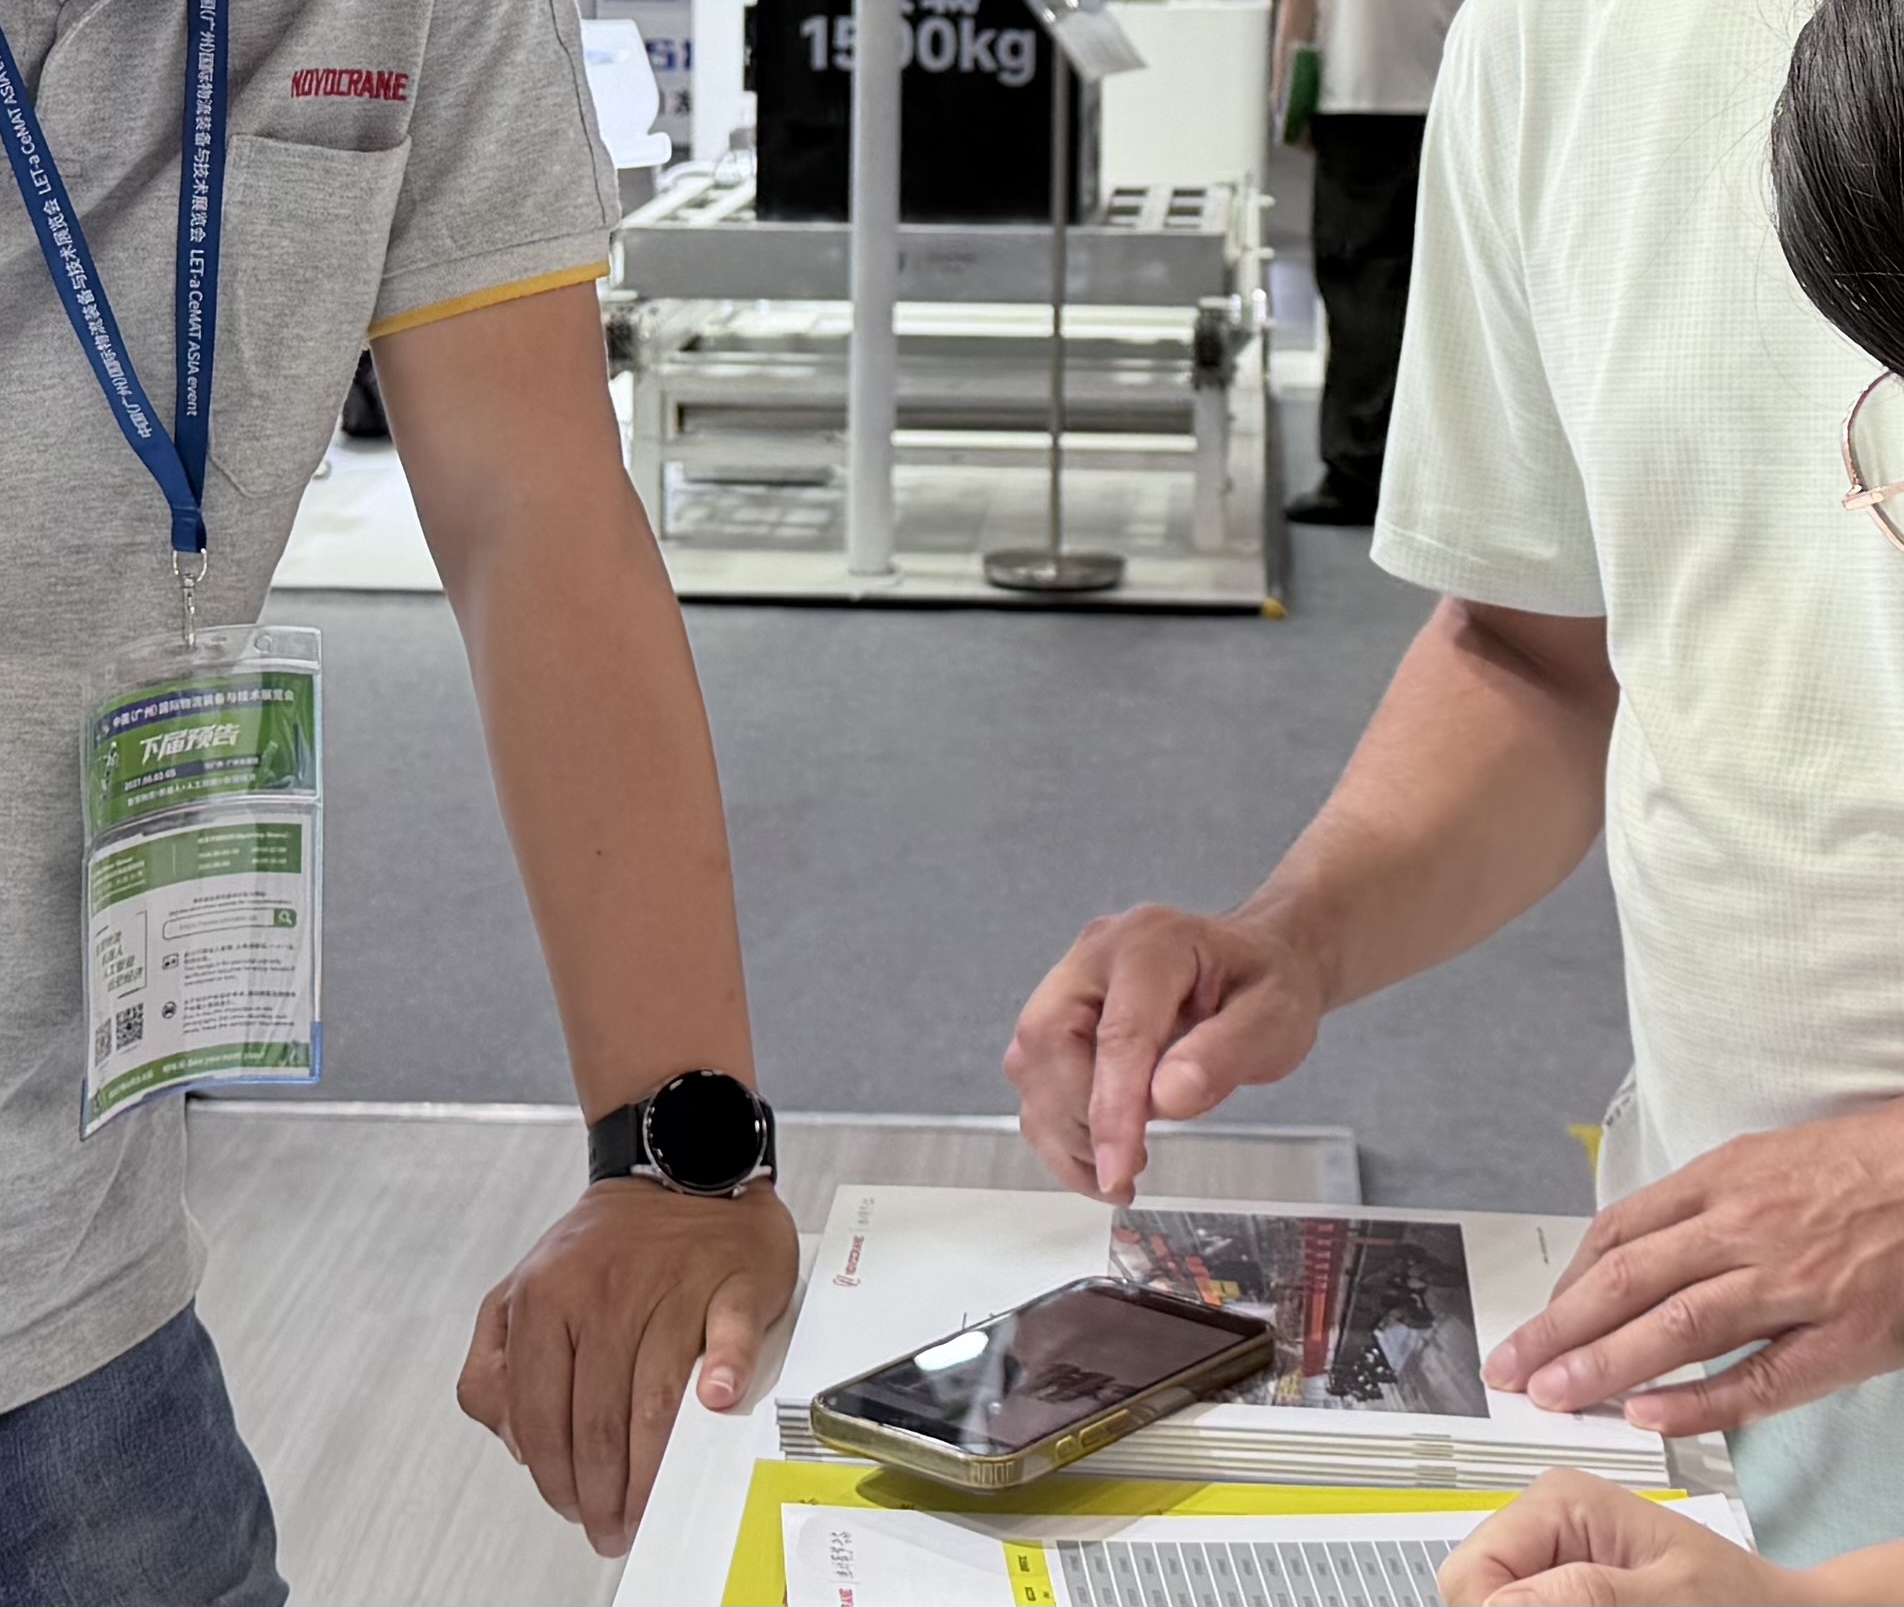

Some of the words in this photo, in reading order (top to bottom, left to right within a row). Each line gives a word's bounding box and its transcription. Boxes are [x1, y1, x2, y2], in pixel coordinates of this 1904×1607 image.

[291, 68, 409, 102] NOVOCRANE
[7, 107, 34, 154] CeMAT
[24, 152, 52, 195] LET-a
[187, 249, 205, 289] LET-a
[186, 290, 204, 340] CeMAT
[185, 341, 201, 375] ASIA
[183, 375, 198, 417] event
[139, 723, 240, 767] 下届预告
